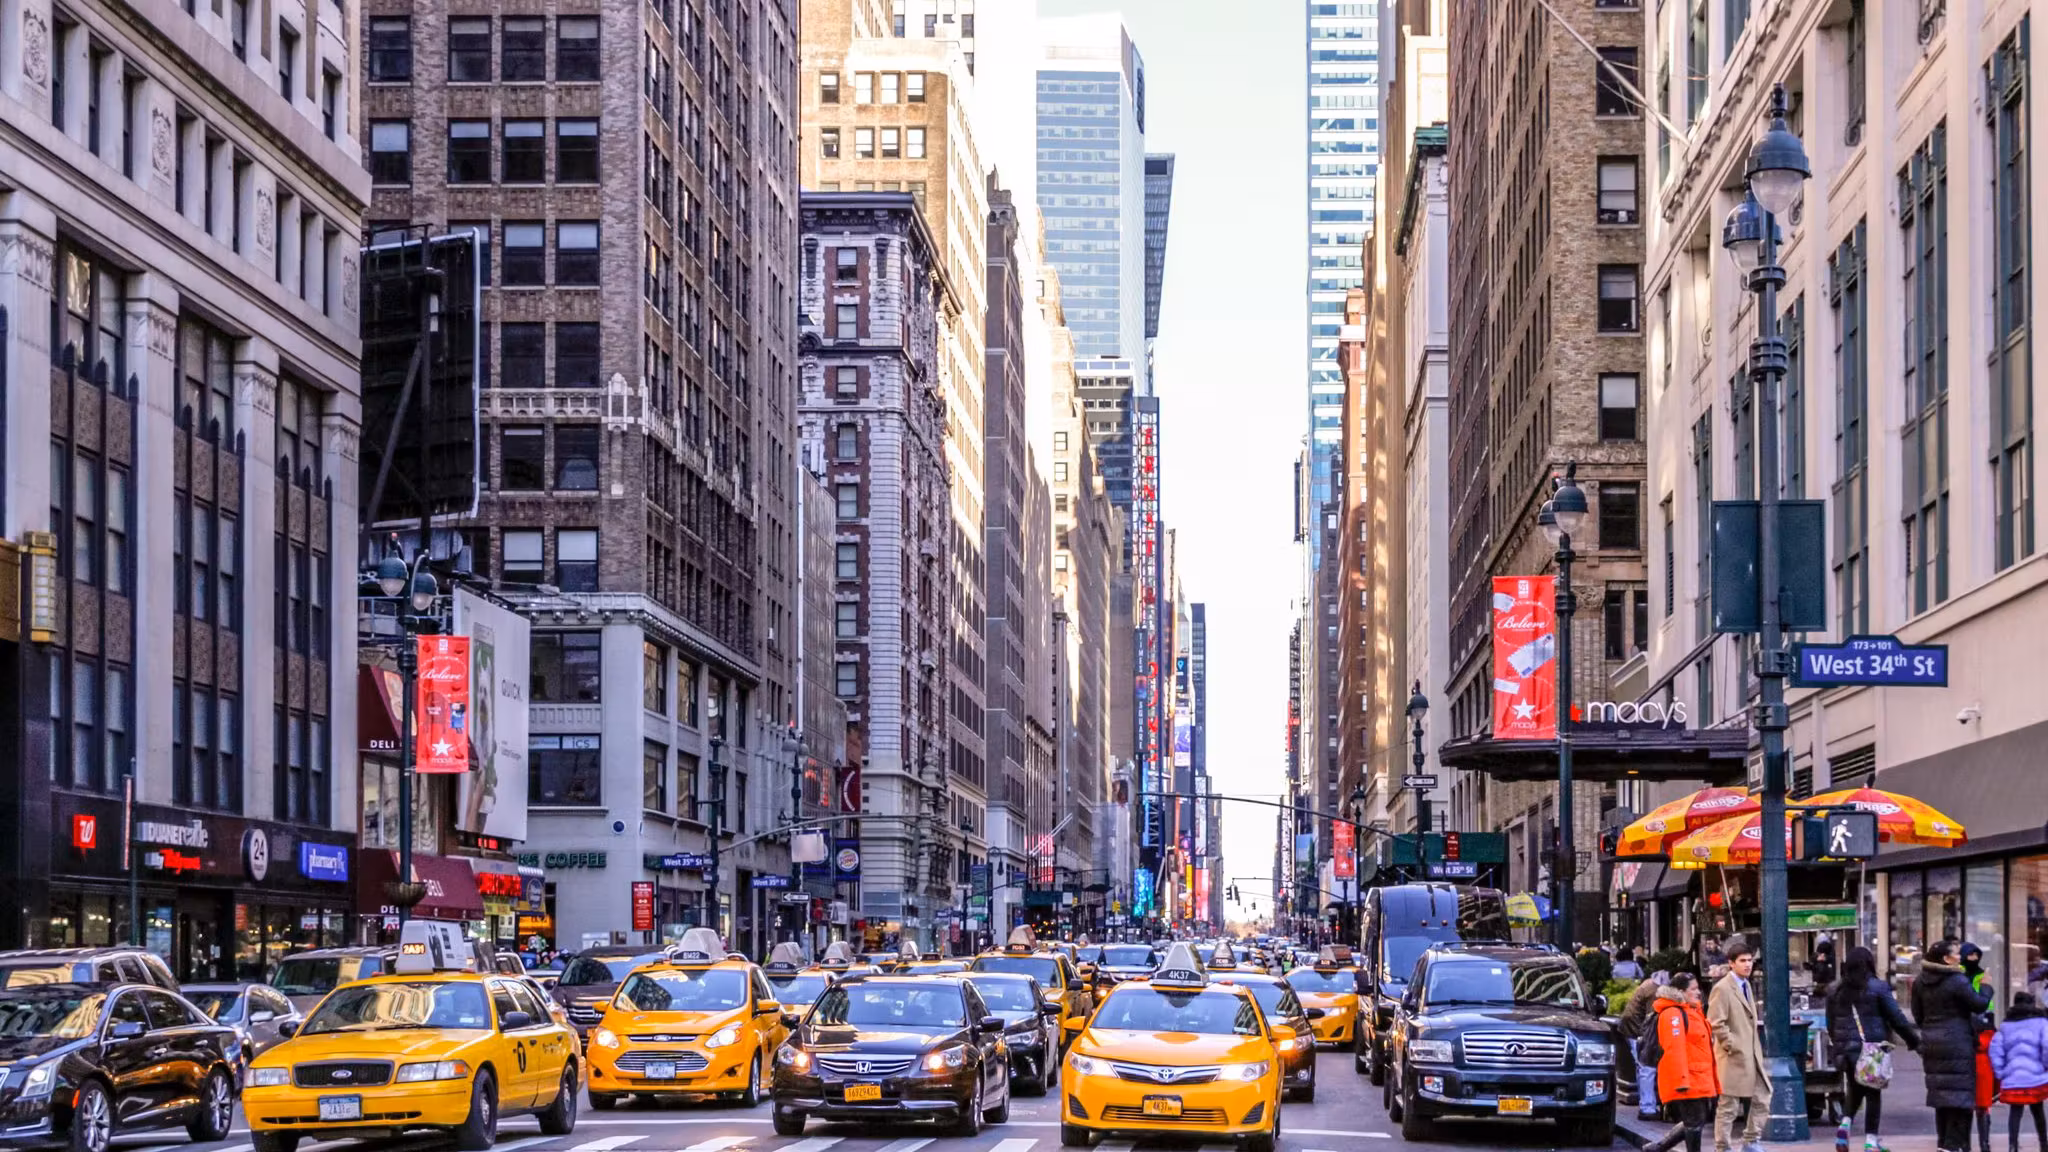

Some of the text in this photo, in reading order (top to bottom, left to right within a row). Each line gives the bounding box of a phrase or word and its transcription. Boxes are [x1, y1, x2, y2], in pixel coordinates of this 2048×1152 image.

[1498, 612, 1548, 630] Believe
[1853, 641, 1893, 650] 173 101
[1810, 653, 1936, 676] West 34th St
[420, 666, 464, 681] Believe
[1586, 696, 1688, 729] macy's
[370, 739, 394, 749] DELI
[254, 839, 265, 860] 24
[545, 853, 607, 868] COFFEE
[664, 858, 681, 866] West
[682, 858, 695, 866] 35th
[1451, 866, 1465, 874] 35th
[1466, 866, 1474, 874] St
[381, 905, 399, 914] DEL
[403, 943, 425, 954] 2A31
[1168, 971, 1190, 981] 4K37
